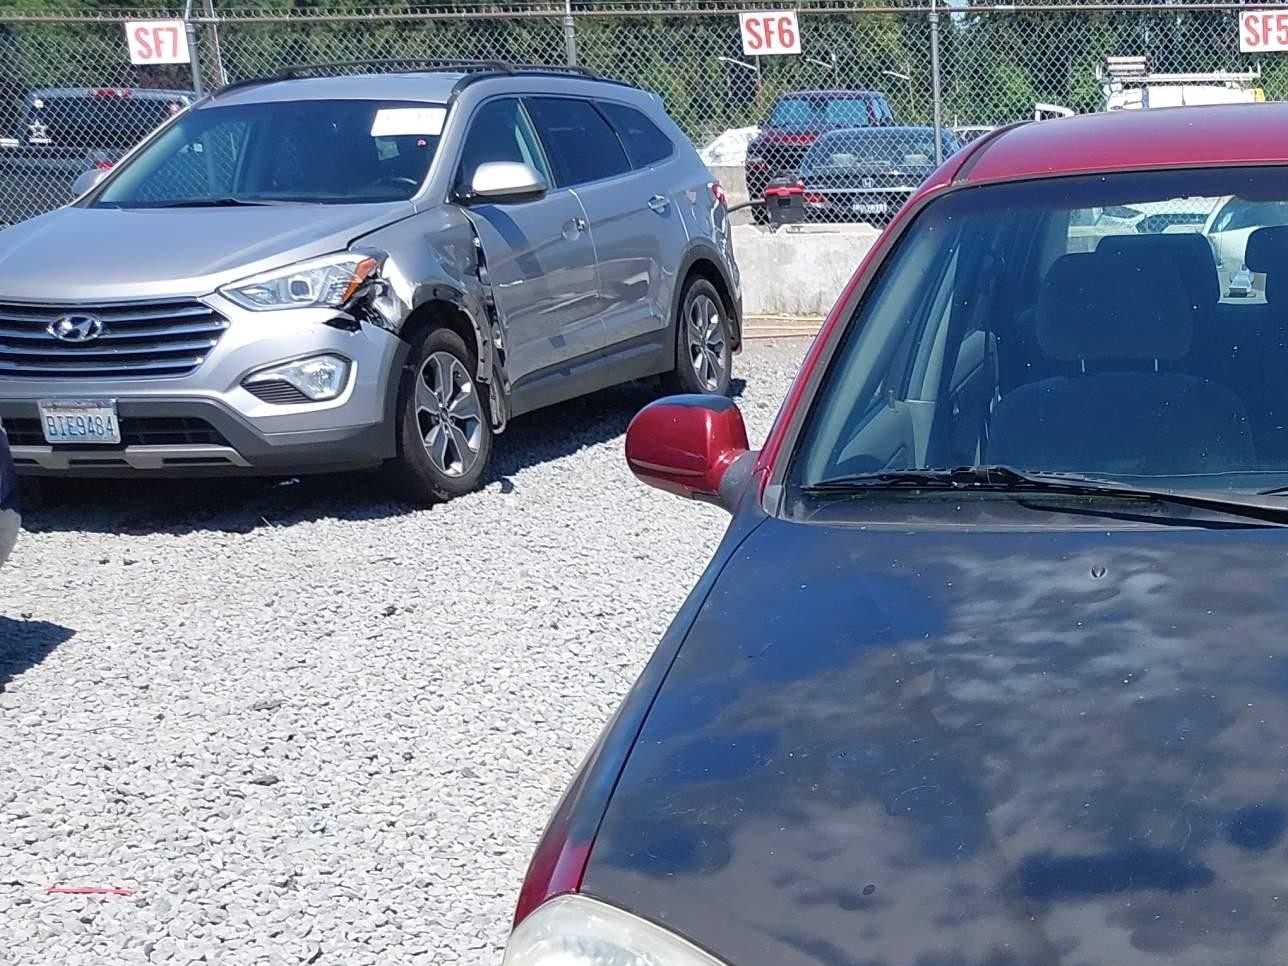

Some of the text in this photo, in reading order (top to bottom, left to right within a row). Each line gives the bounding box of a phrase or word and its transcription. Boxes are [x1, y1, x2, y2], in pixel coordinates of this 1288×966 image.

[134, 27, 179, 59] SF7
[745, 17, 796, 50] SF6
[46, 414, 114, 436] BIE9484
